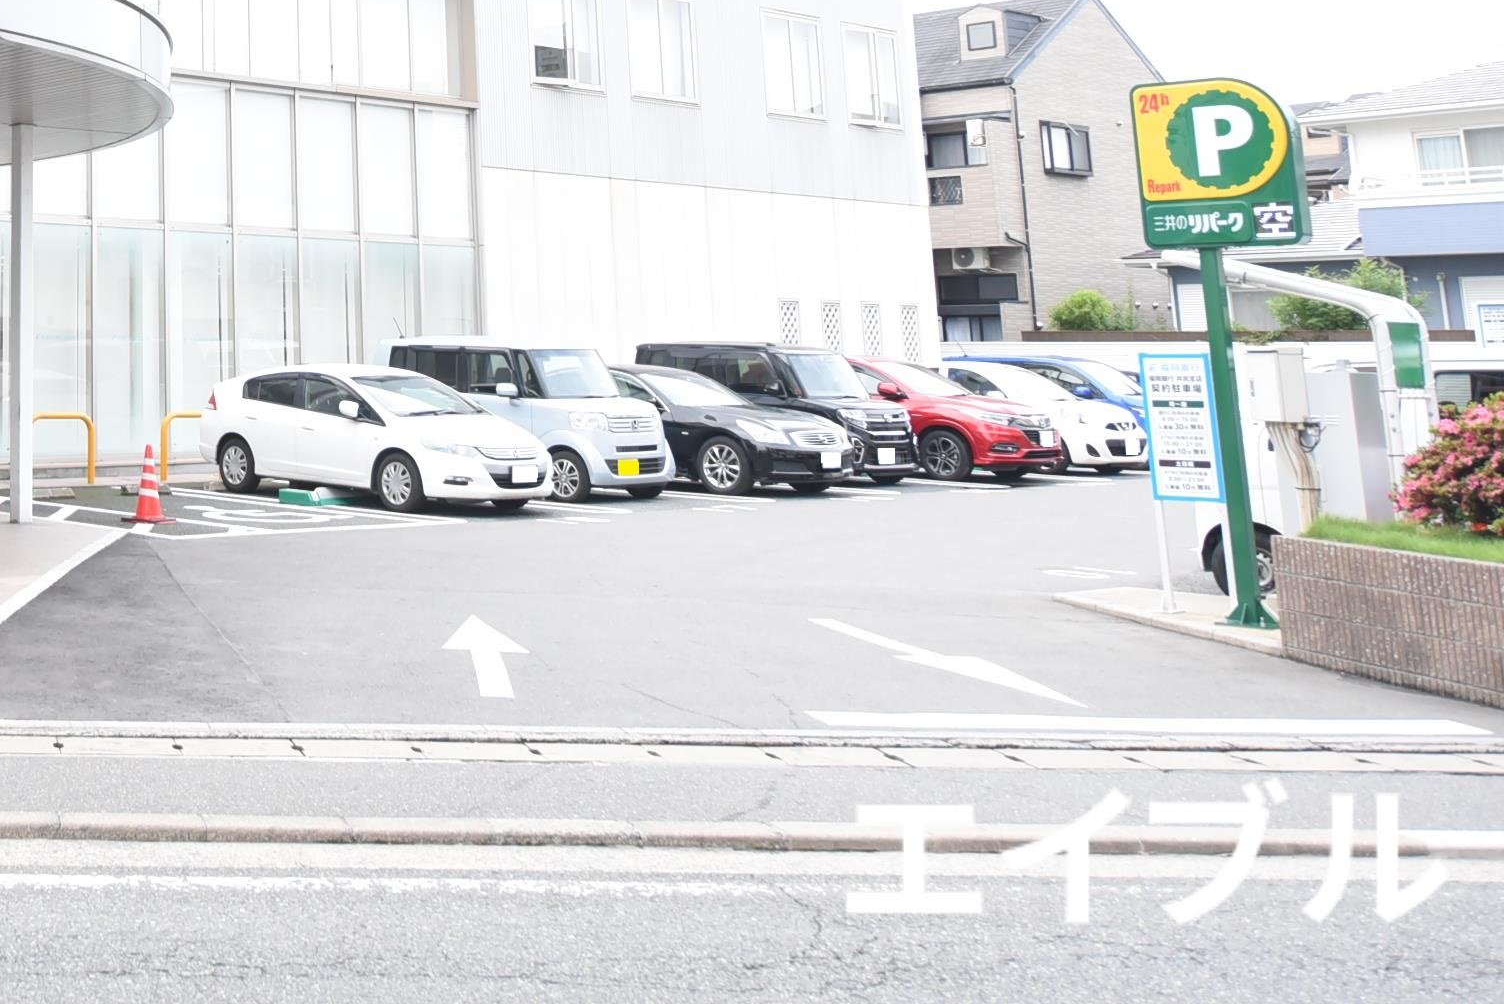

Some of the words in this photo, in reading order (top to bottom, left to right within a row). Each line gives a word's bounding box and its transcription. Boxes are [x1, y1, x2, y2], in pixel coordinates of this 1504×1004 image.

[1192, 104, 1254, 178] P
[1147, 179, 1182, 195] Repark
[1253, 202, 1297, 239] 空
